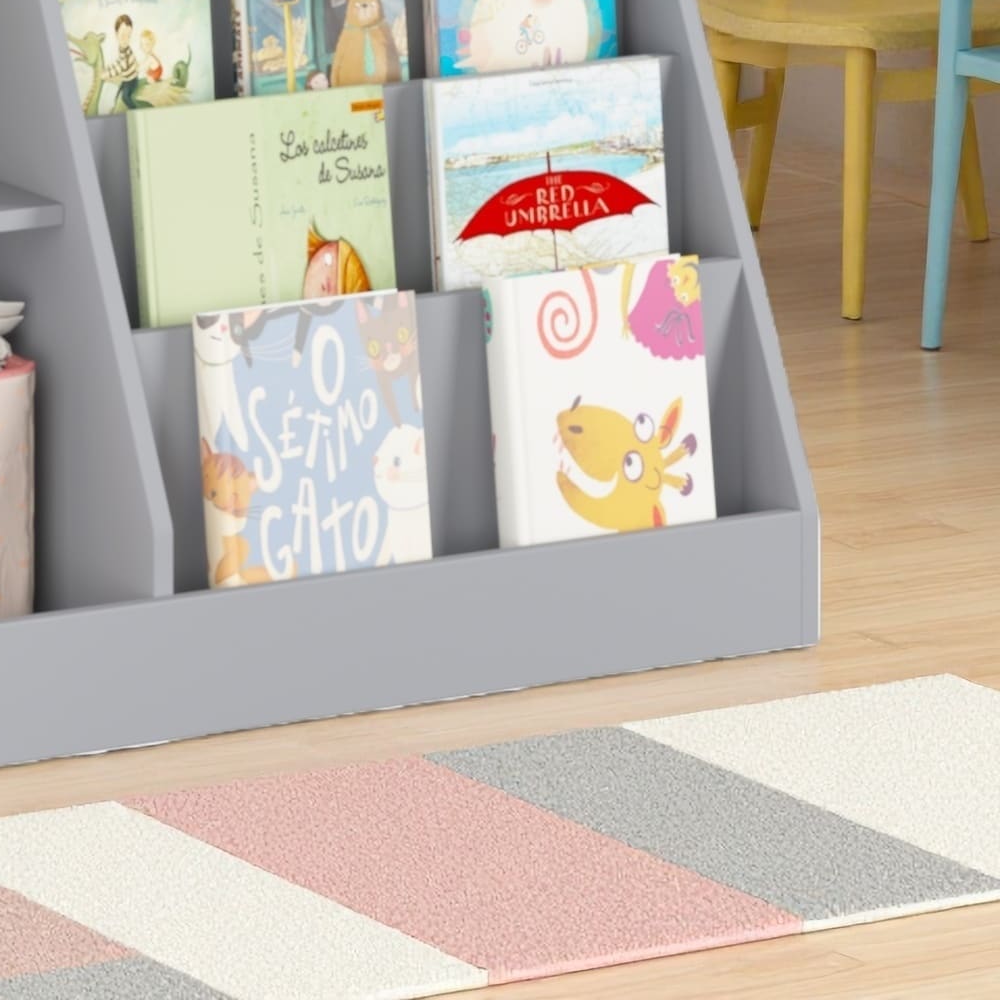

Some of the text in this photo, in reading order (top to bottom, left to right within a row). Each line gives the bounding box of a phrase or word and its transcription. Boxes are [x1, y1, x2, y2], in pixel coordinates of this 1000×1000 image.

[279, 128, 369, 163] Los calcetines
[318, 156, 385, 184] de Susana
[536, 184, 575, 206] RED
[504, 197, 610, 227] UMBRELLA
[311, 325, 345, 406] O
[260, 476, 379, 581] GATO
